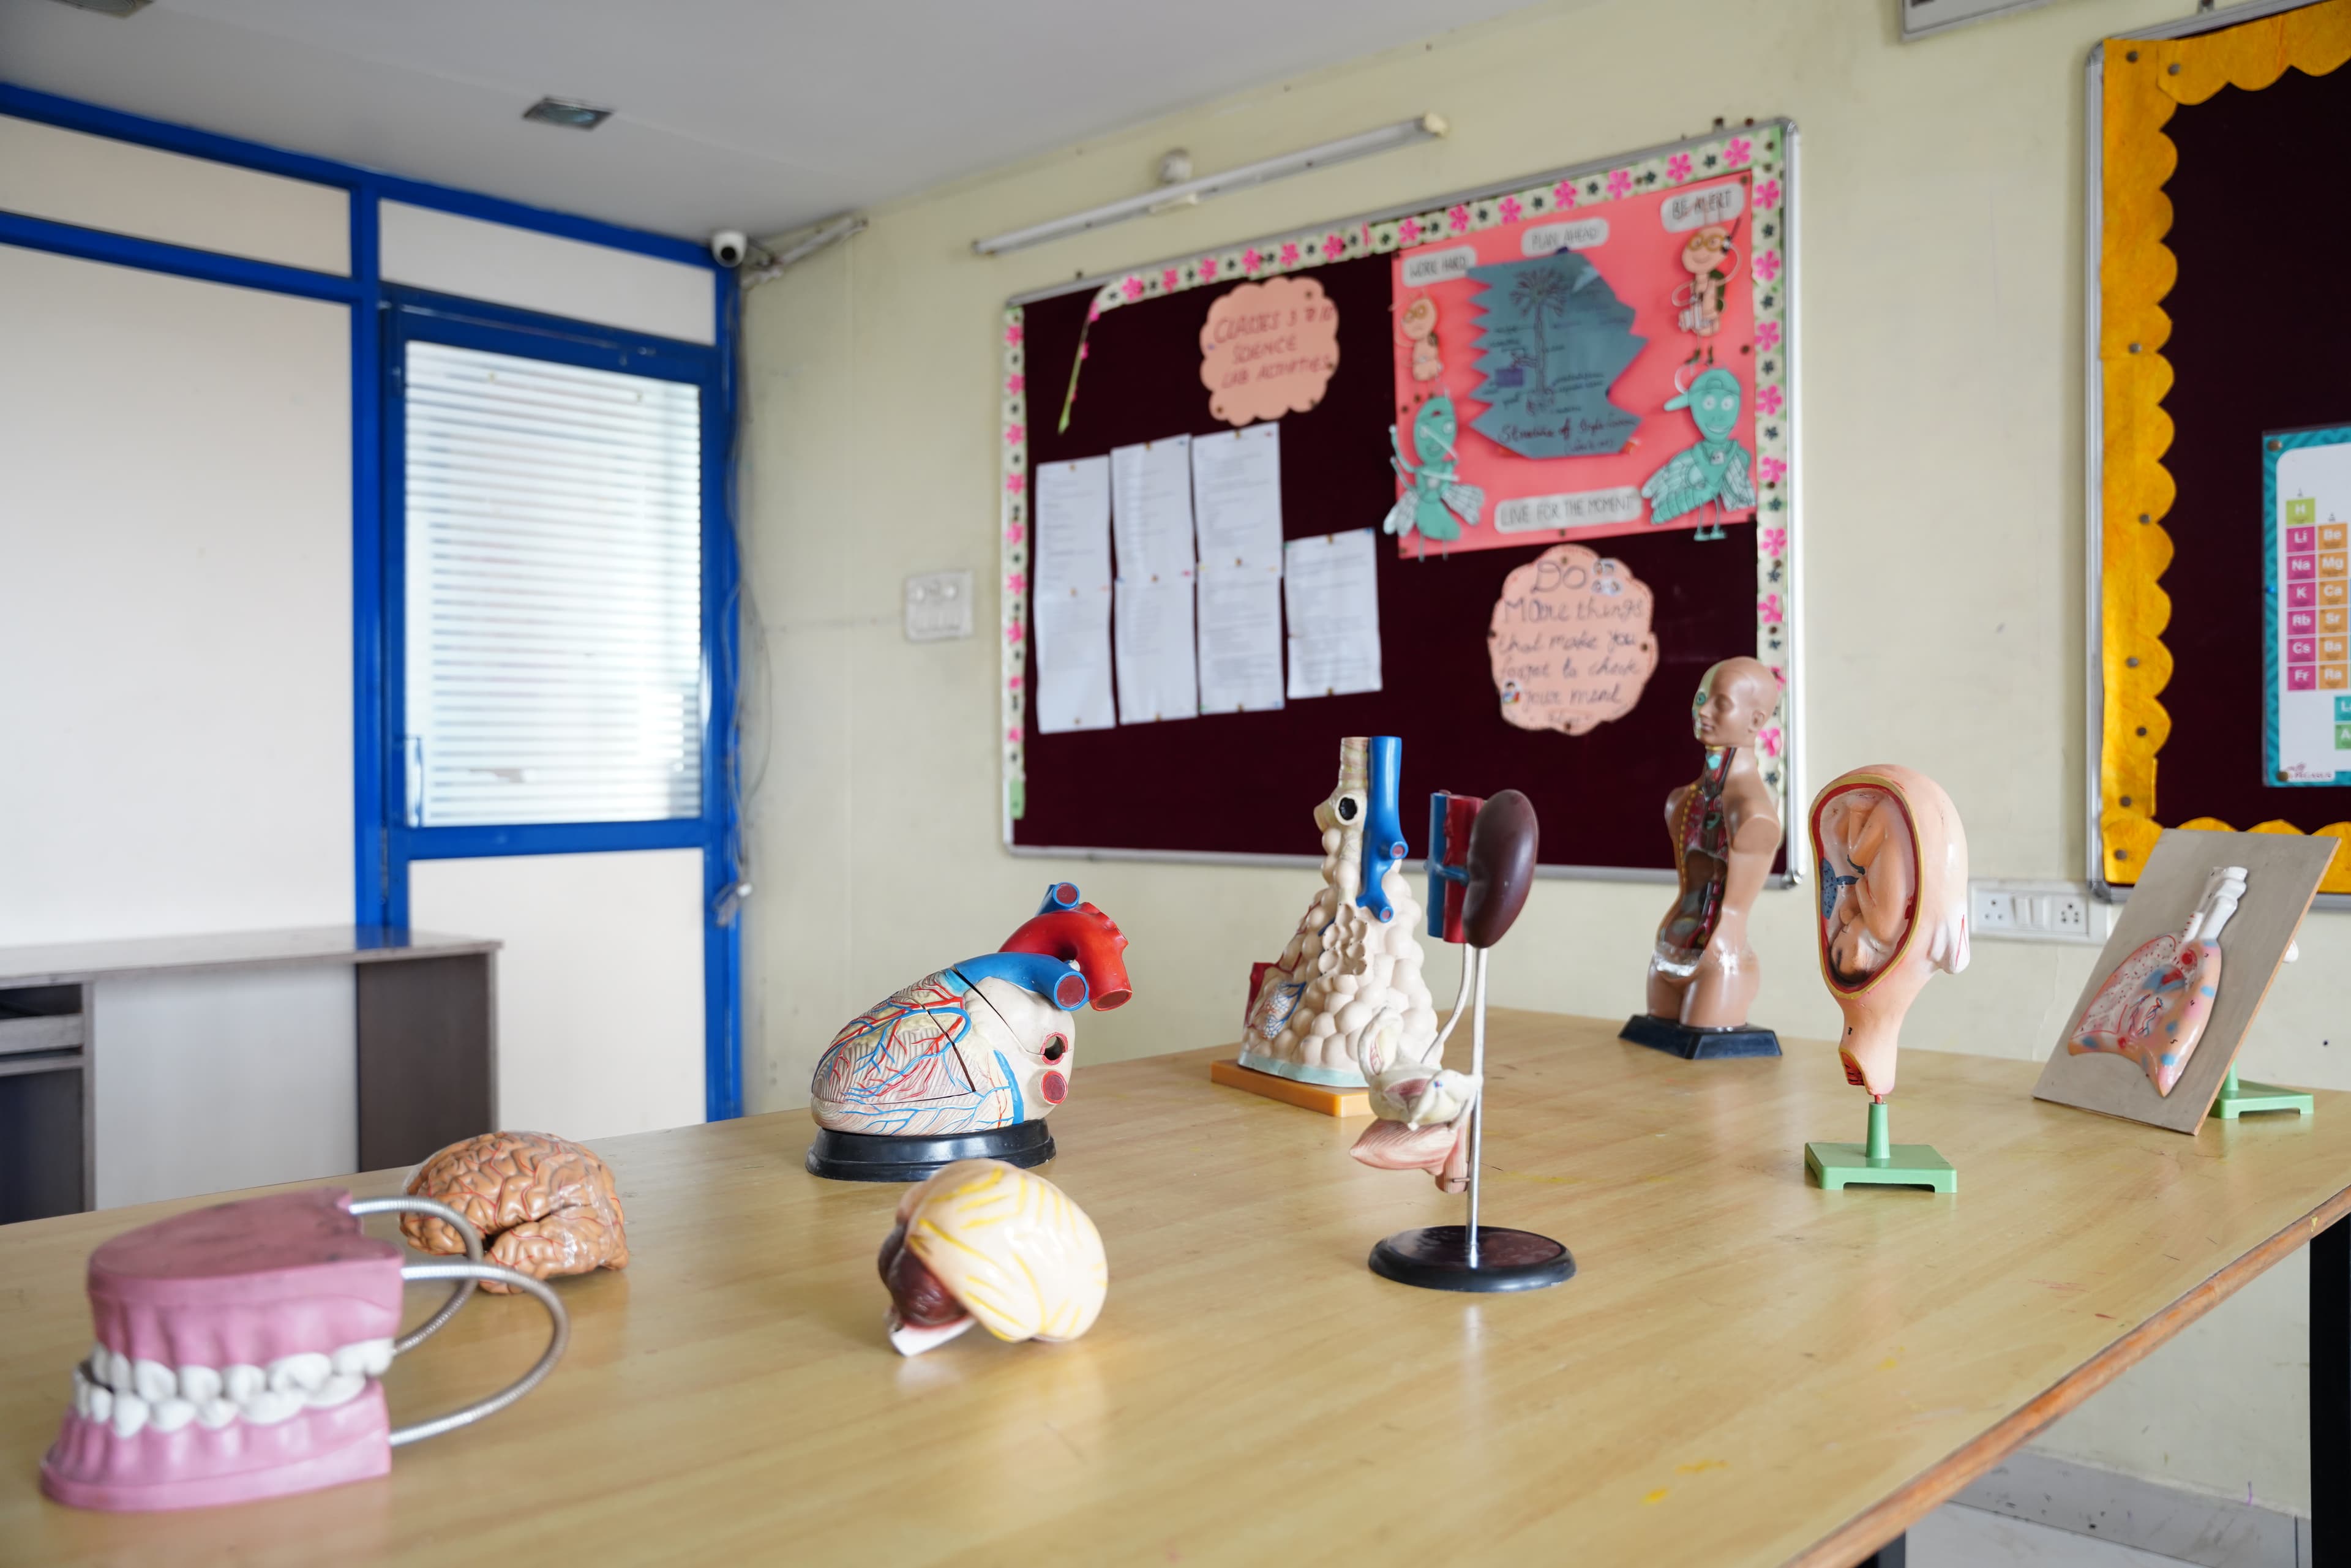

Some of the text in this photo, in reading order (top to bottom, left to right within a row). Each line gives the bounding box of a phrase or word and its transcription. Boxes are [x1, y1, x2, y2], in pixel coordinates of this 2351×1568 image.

[1672, 199, 1687, 220] BE
[1501, 504, 1529, 527] LIVE
[1536, 501, 1559, 520] FOR
[1588, 494, 1633, 514] MOMENT
[2295, 504, 2306, 515] H
[2293, 530, 2308, 543] Li
[2323, 528, 2342, 541] Be
[2292, 558, 2311, 571] Na
[2322, 556, 2344, 571] Mg
[2296, 586, 2308, 598] K
[2323, 584, 2343, 596] Ca
[2292, 613, 2311, 626] Rb
[2325, 612, 2341, 625] Sr
[2292, 642, 2311, 654] Cs
[2323, 640, 2342, 653] Ba
[2294, 669, 2309, 681] Fr
